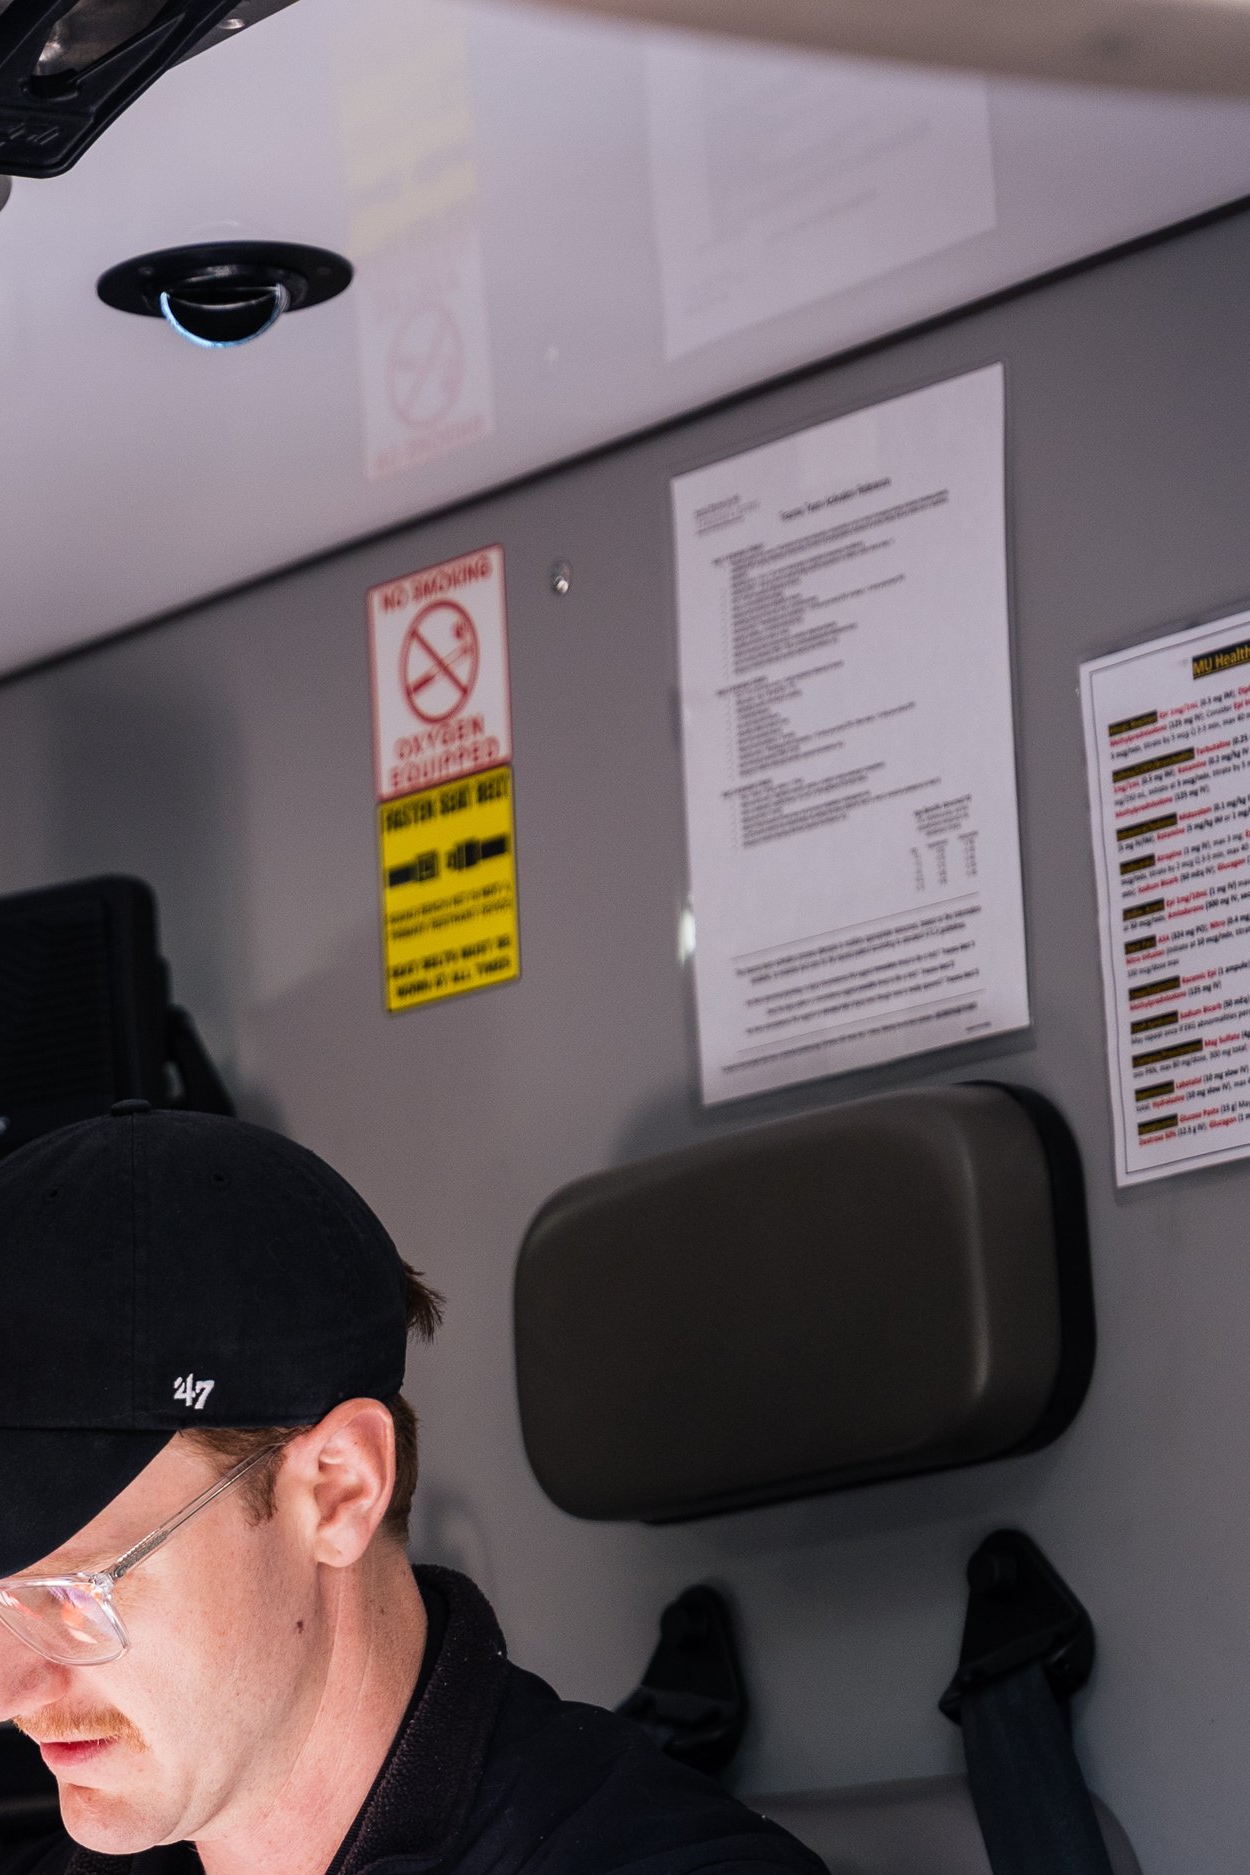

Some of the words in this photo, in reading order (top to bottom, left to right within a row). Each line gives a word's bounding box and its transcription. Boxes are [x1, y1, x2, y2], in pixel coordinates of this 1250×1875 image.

[381, 581, 407, 612] NO
[412, 552, 490, 602] SMOKING
[1193, 656, 1212, 675] MU
[394, 712, 484, 760] OXYGEN
[389, 733, 499, 789] EQUIPPED
[385, 796, 434, 831] FASTEN
